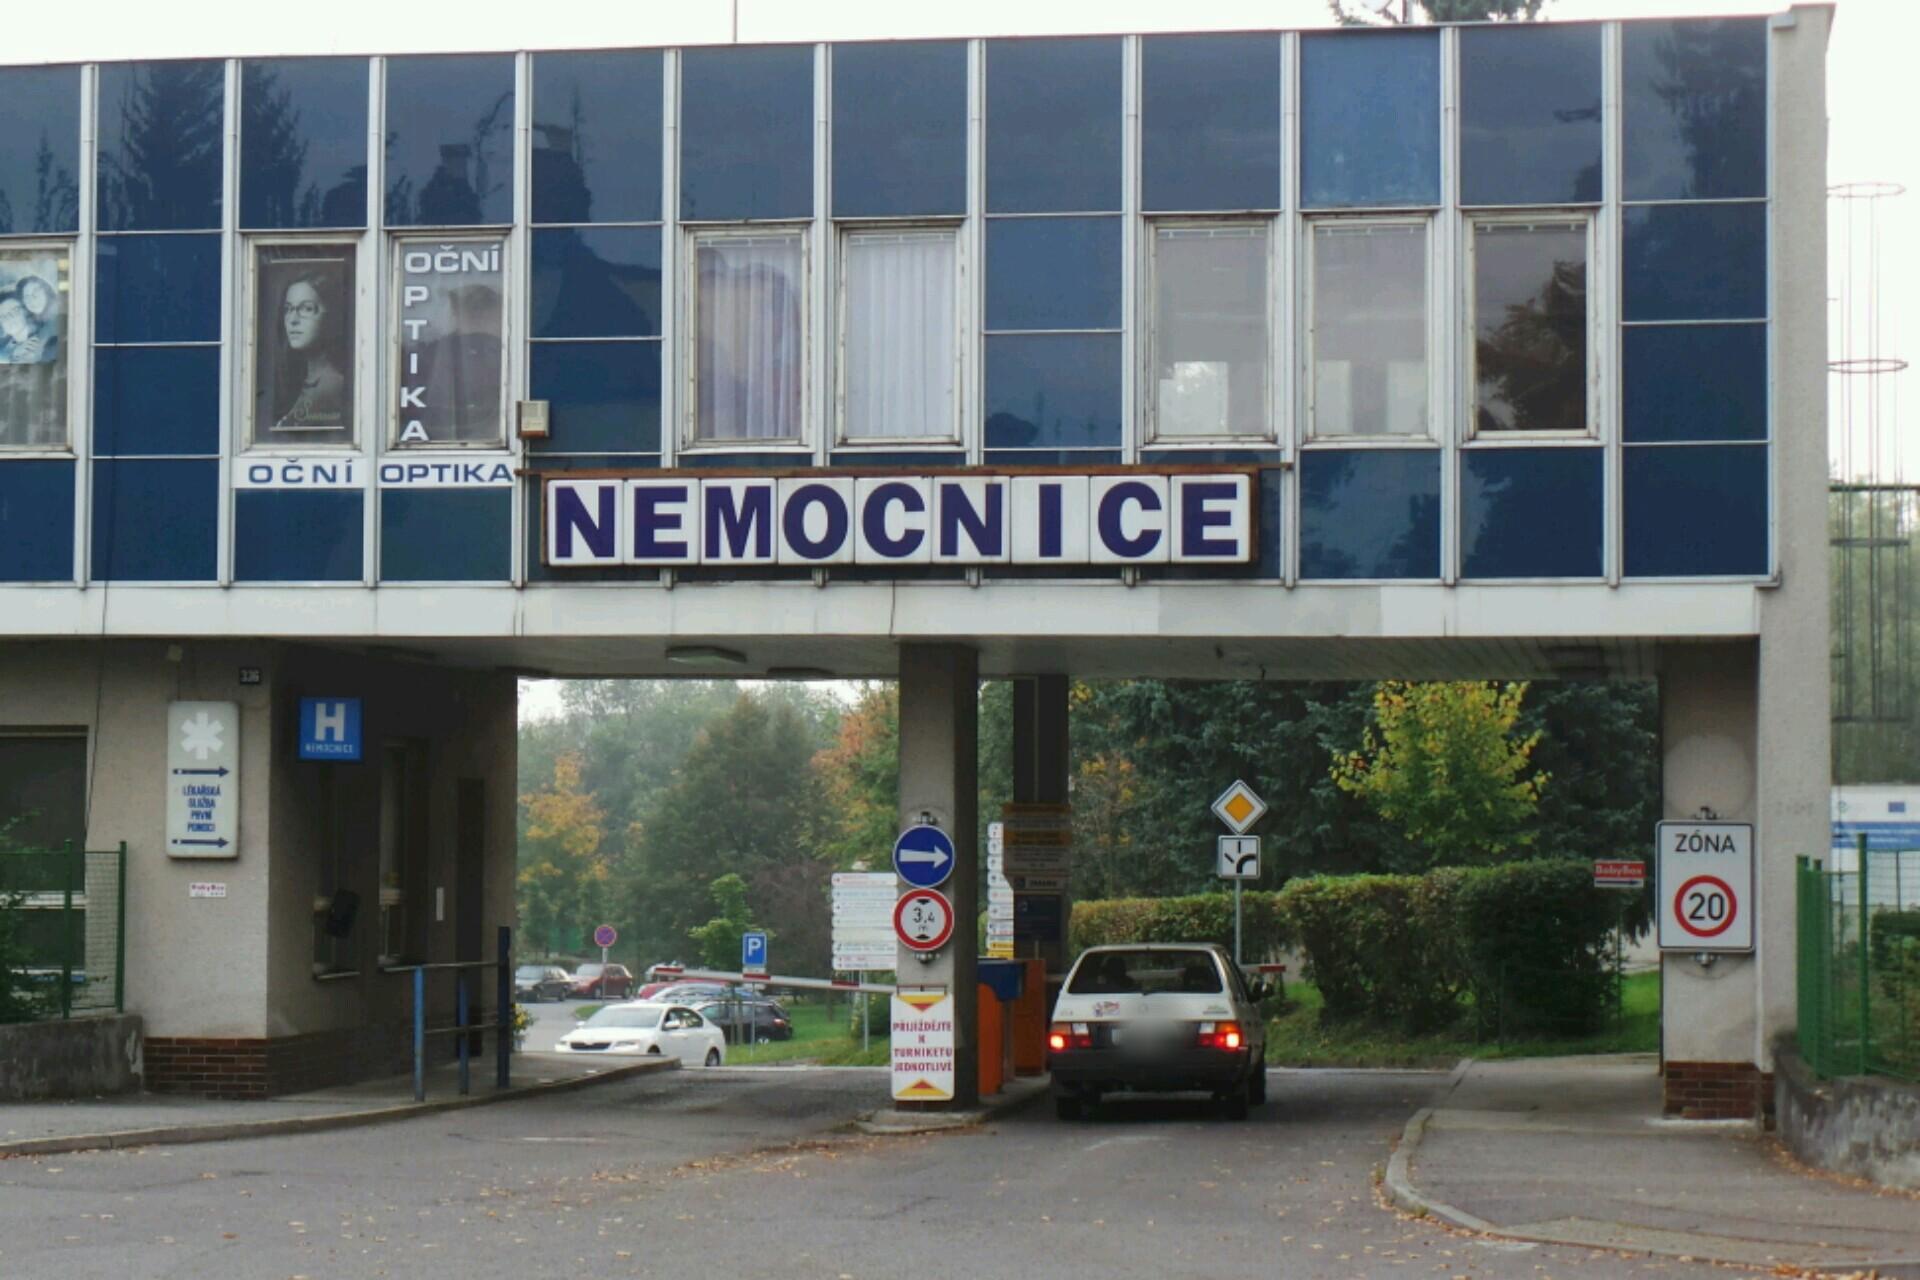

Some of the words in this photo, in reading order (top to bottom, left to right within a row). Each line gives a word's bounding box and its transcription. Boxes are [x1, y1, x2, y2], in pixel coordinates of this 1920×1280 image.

[404, 244, 500, 273] OČNÍ
[248, 457, 353, 485] OČNÍ
[379, 463, 513, 483] OPTIKA
[555, 482, 1240, 561] NEMOCNICE
[315, 703, 345, 742] H
[1674, 829, 1736, 853] ZÓNA
[1688, 892, 1724, 921] 20
[748, 938, 762, 956] P
